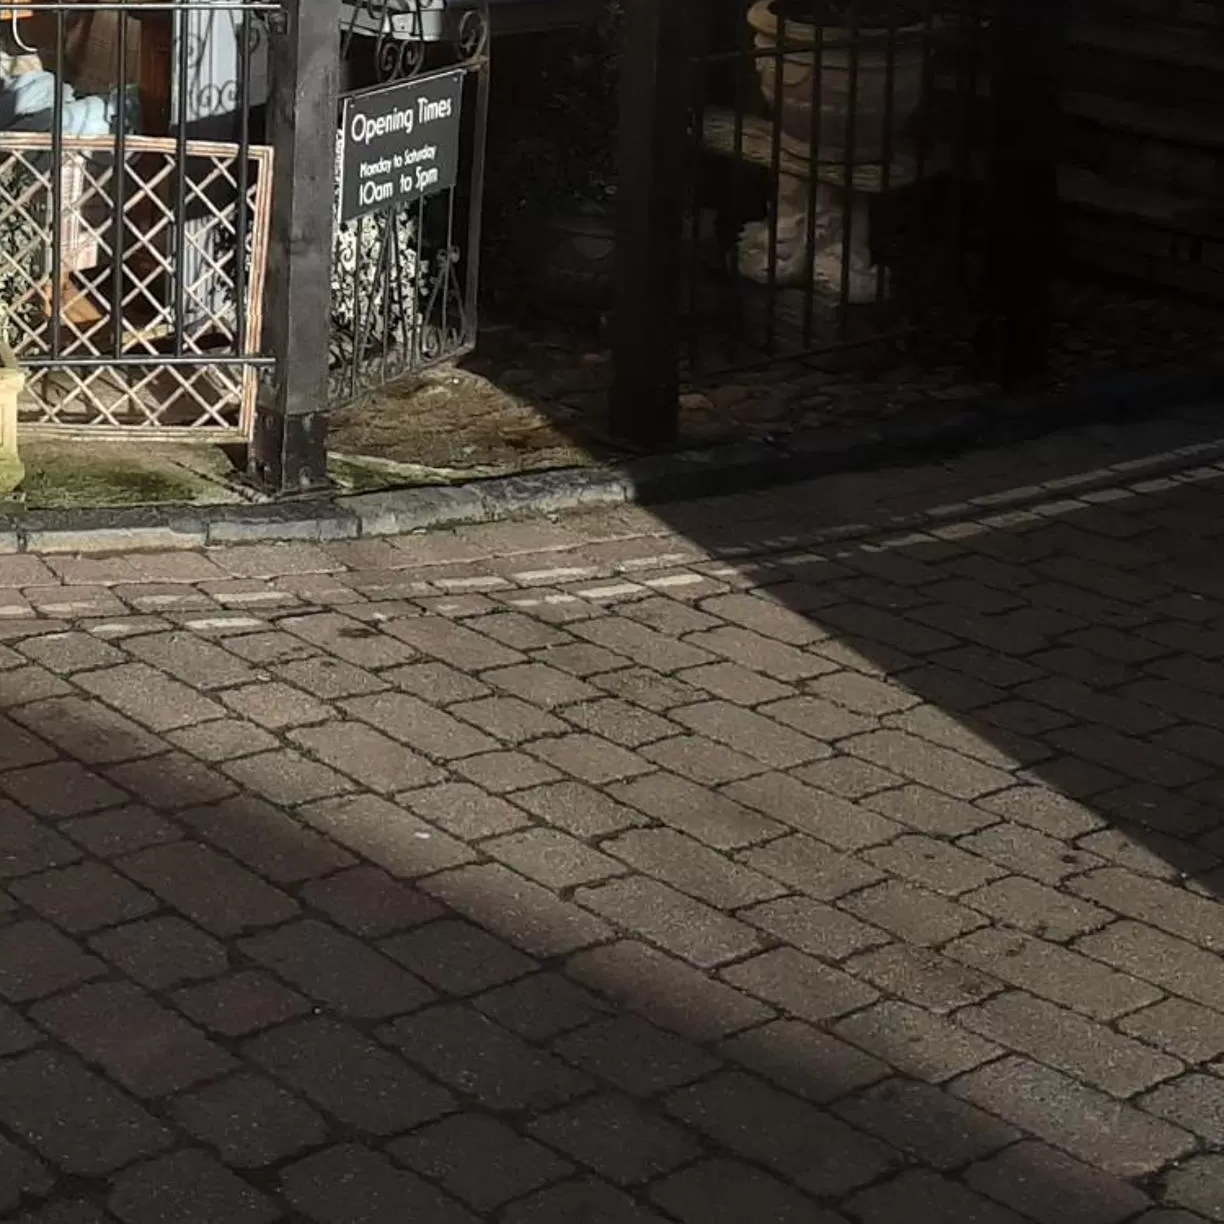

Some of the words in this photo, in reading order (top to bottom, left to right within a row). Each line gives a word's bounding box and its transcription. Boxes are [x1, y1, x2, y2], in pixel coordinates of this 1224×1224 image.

[351, 107, 414, 145] Opening
[417, 97, 452, 124] Times
[359, 156, 392, 178] Monday
[393, 154, 403, 168] to
[404, 144, 437, 165] Saturday
[359, 181, 393, 206] 10am
[400, 173, 412, 193] to
[415, 166, 438, 192] 5pm
